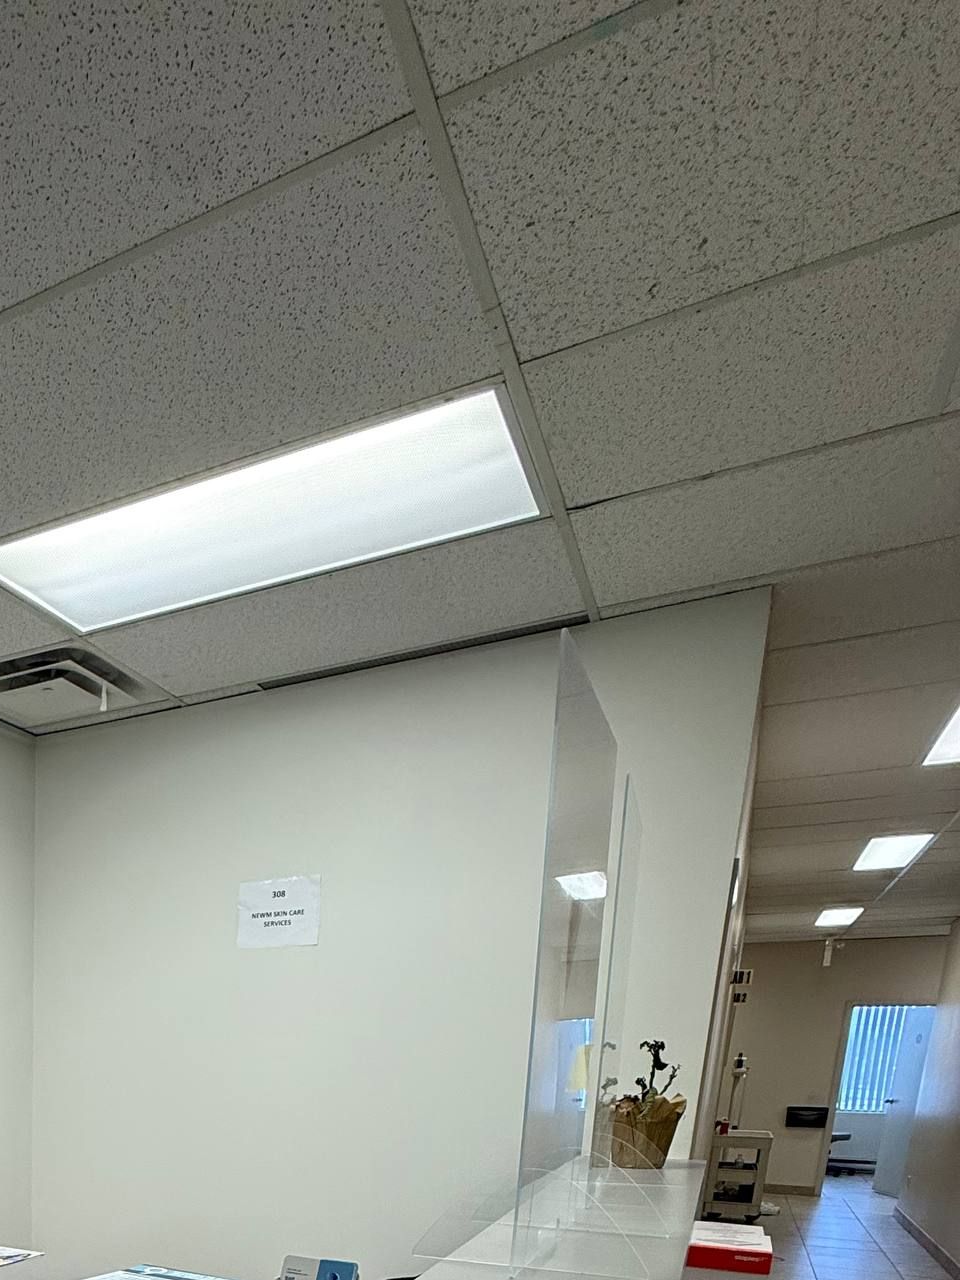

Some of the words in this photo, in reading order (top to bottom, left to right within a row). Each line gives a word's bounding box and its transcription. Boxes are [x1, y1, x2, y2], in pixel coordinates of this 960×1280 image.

[271, 890, 286, 898] 308
[263, 919, 292, 928] SERVICES
[746, 970, 751, 984] 1
[742, 992, 747, 1002] 2
